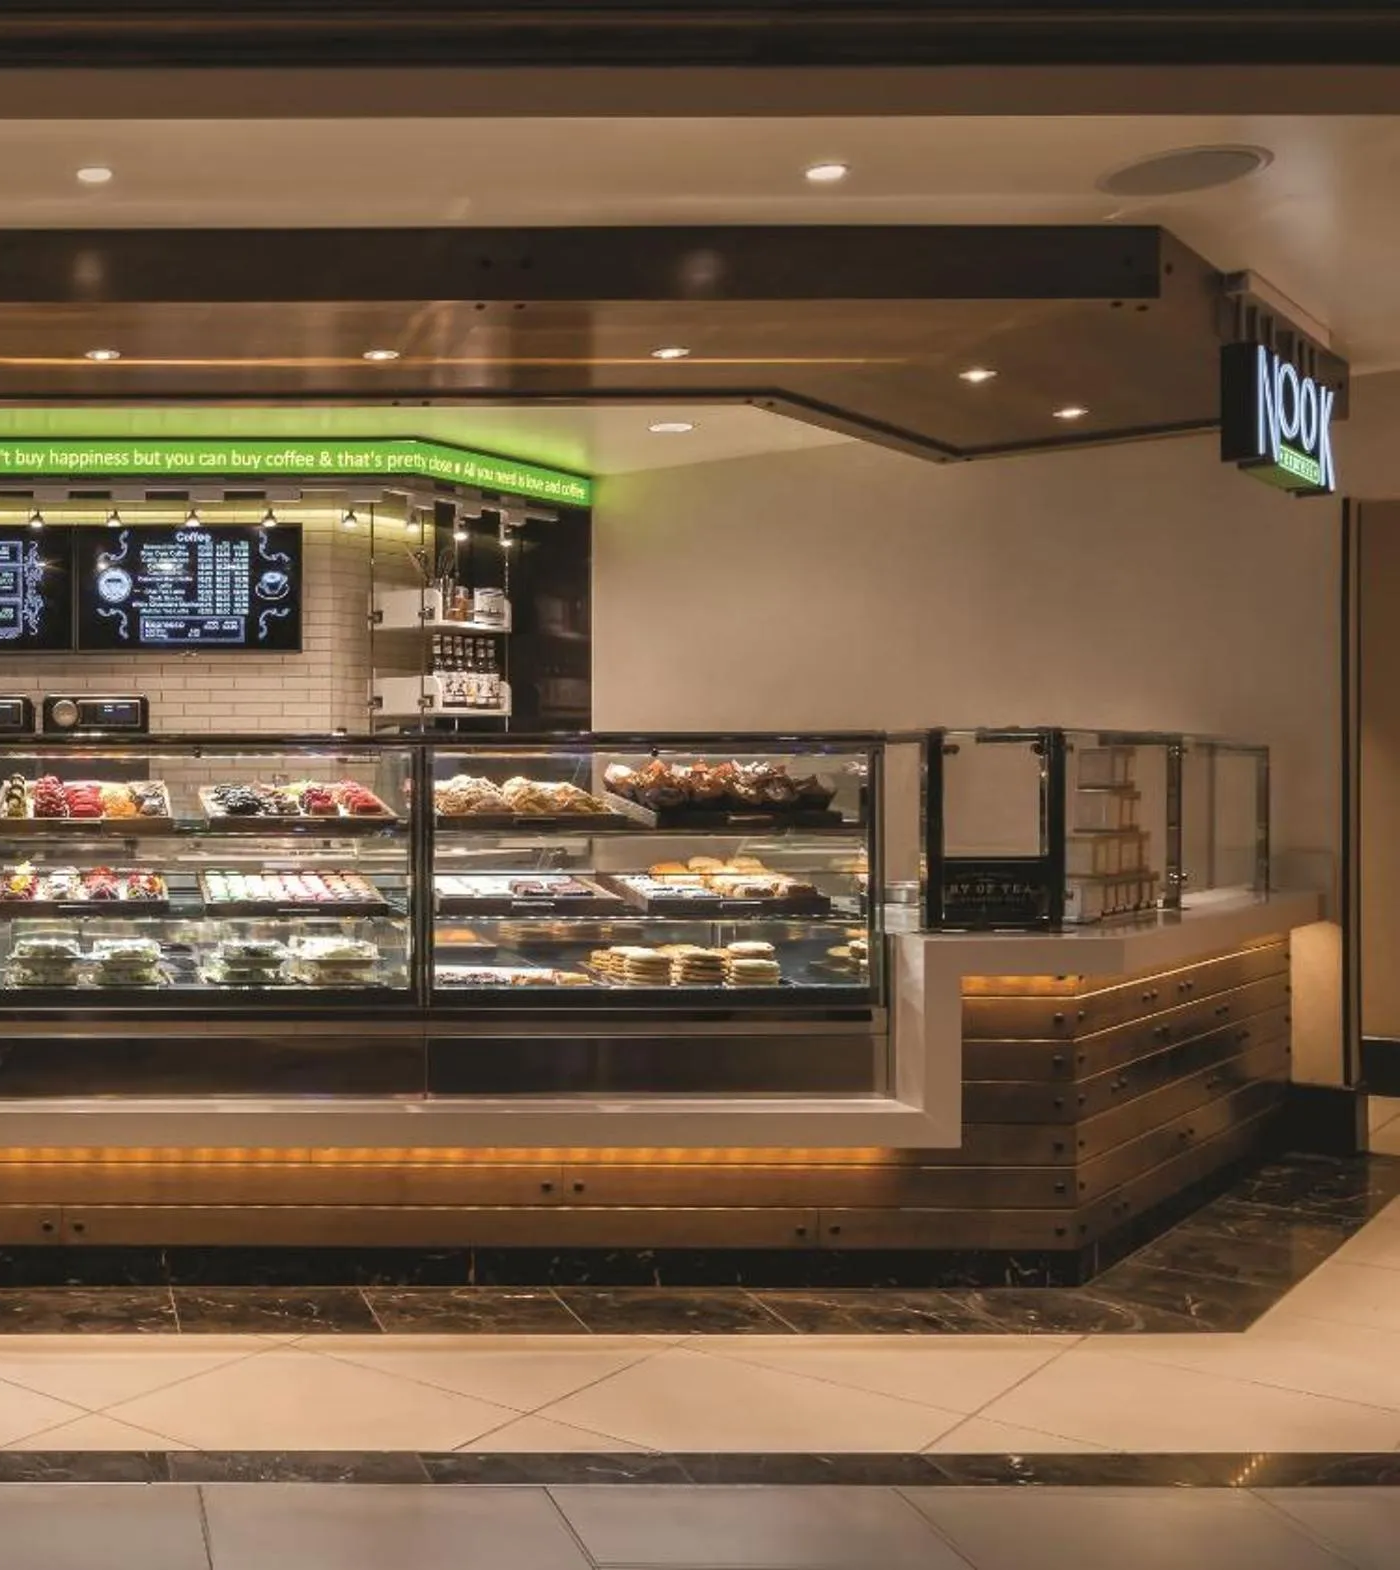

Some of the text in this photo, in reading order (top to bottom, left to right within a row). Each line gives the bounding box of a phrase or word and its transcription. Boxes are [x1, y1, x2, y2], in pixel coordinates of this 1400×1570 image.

[1258, 345, 1336, 491] NOOK
[15, 449, 46, 469] buy
[50, 449, 130, 470] happiness
[134, 449, 161, 466] but
[165, 452, 195, 470] you
[198, 453, 227, 467] can
[231, 449, 262, 469] buy
[264, 449, 315, 467] coffee
[318, 451, 333, 468] &
[336, 450, 383, 468] that's
[387, 453, 426, 472] pretty
[428, 456, 453, 473] close
[463, 460, 476, 478] All
[476, 466, 494, 484] you
[494, 468, 517, 486] need
[525, 474, 544, 491] love
[543, 478, 561, 494] and
[175, 531, 212, 543] Coffee
